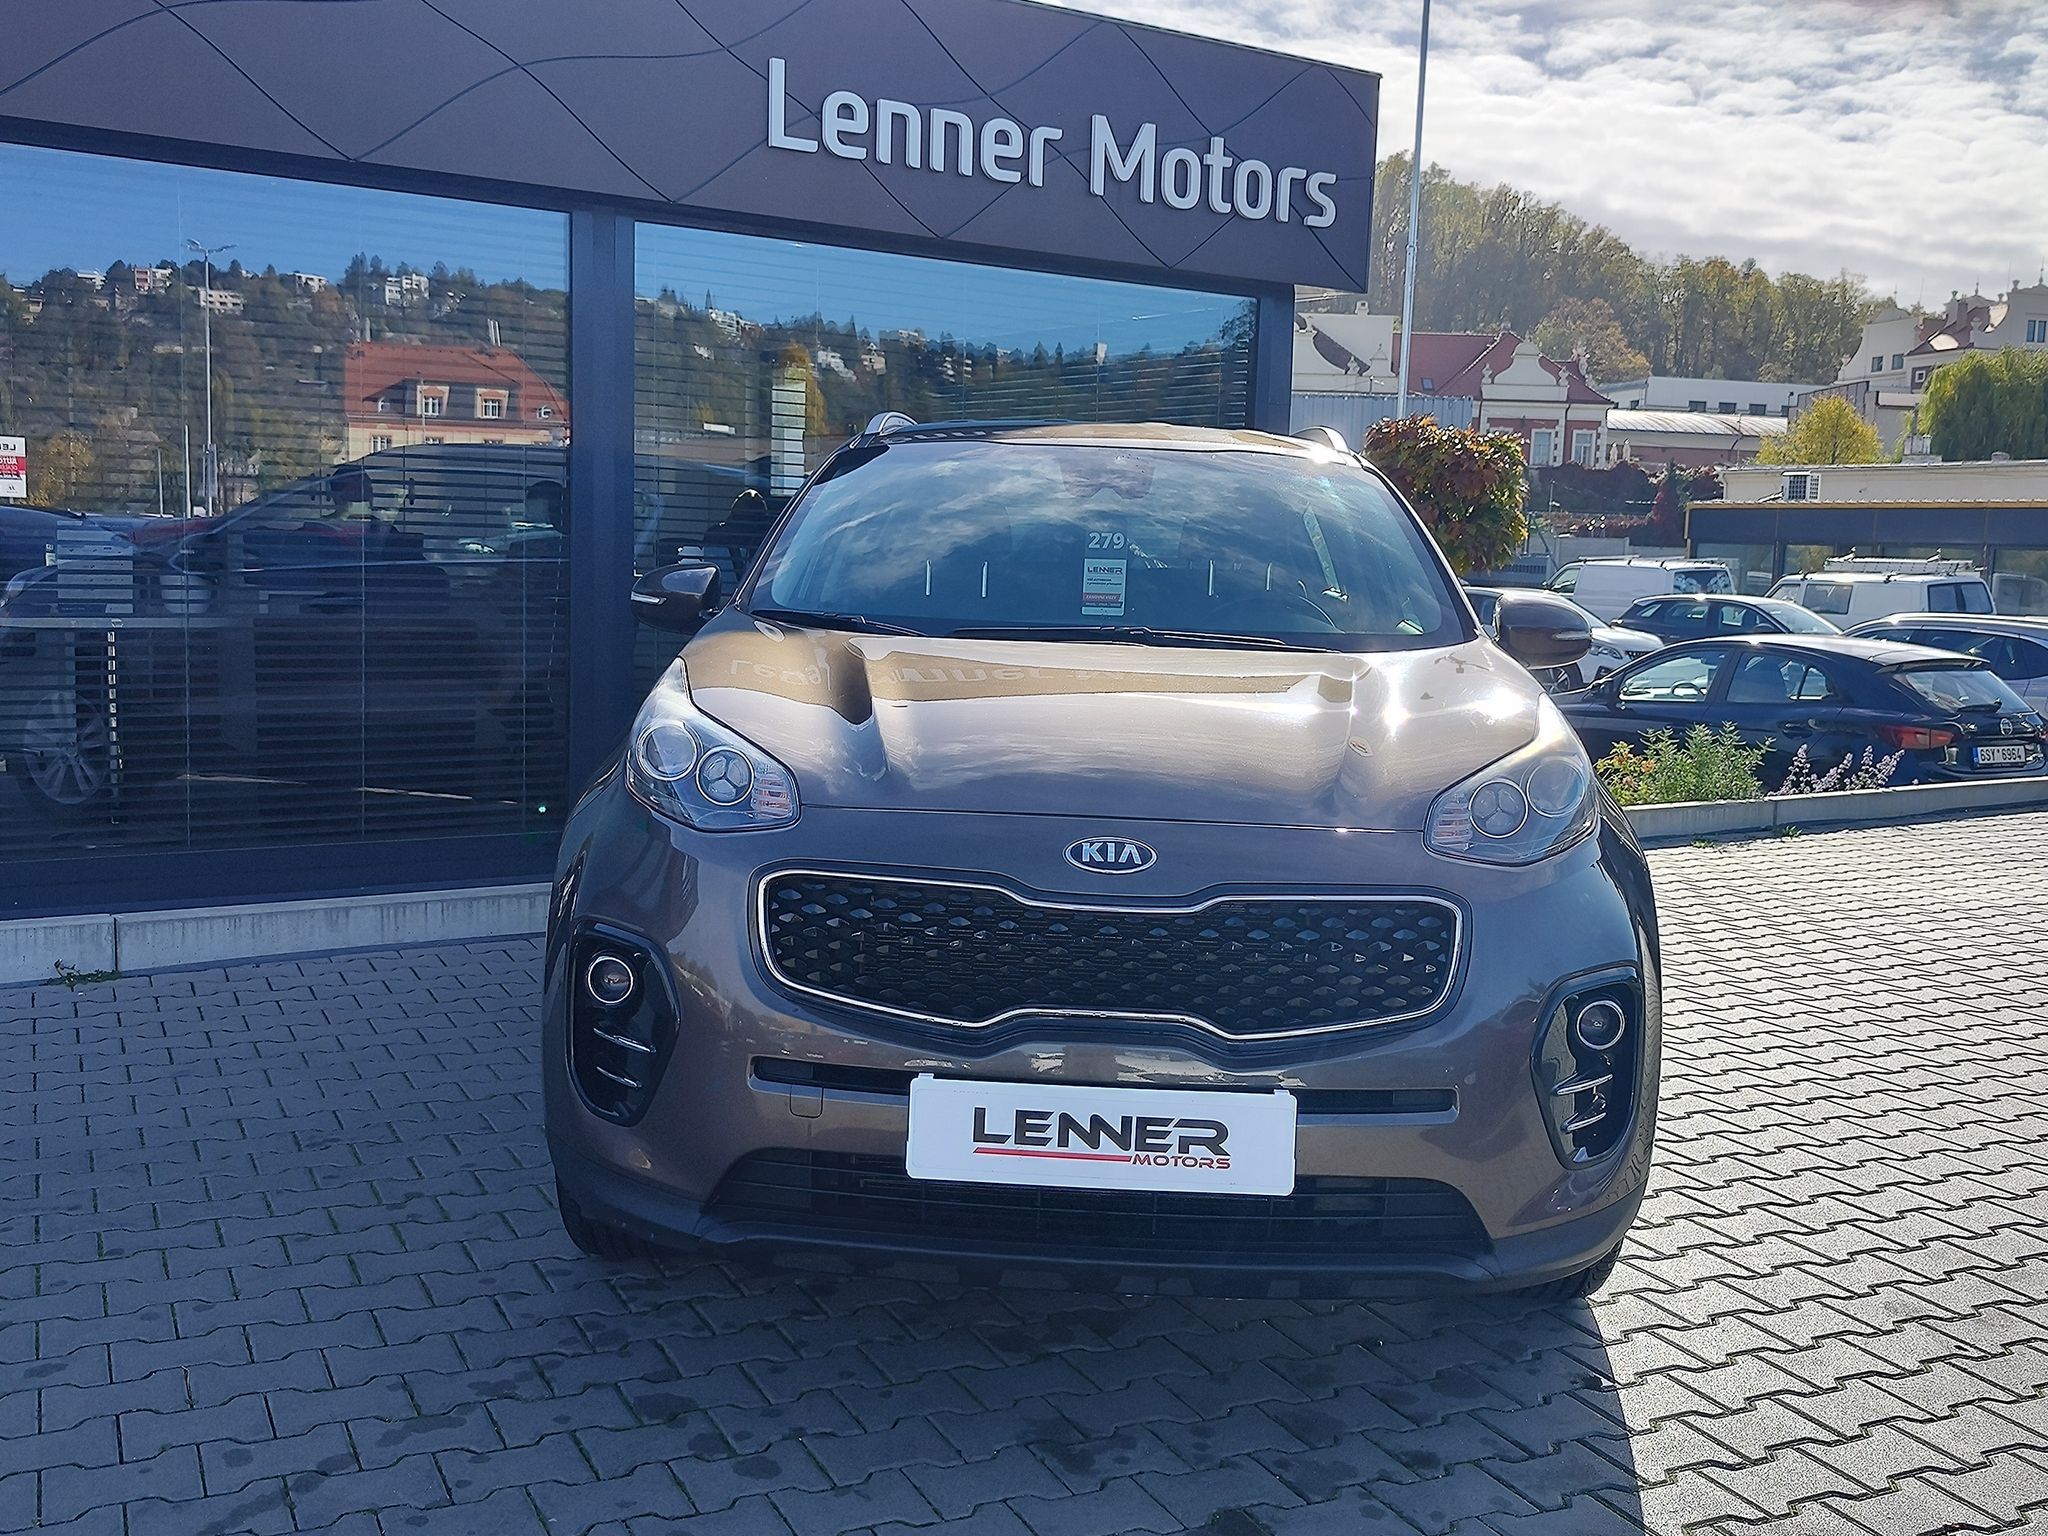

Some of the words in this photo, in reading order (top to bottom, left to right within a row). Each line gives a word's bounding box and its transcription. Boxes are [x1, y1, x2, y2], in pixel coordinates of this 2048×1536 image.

[767, 56, 1063, 188] Lenner
[1089, 113, 1338, 228] Motors
[1088, 532, 1125, 550] 279
[1087, 566, 1123, 576] LENNER
[1081, 842, 1143, 865] KIA
[972, 1106, 1231, 1157] LENNER
[1130, 1154, 1231, 1170] MOTORS
